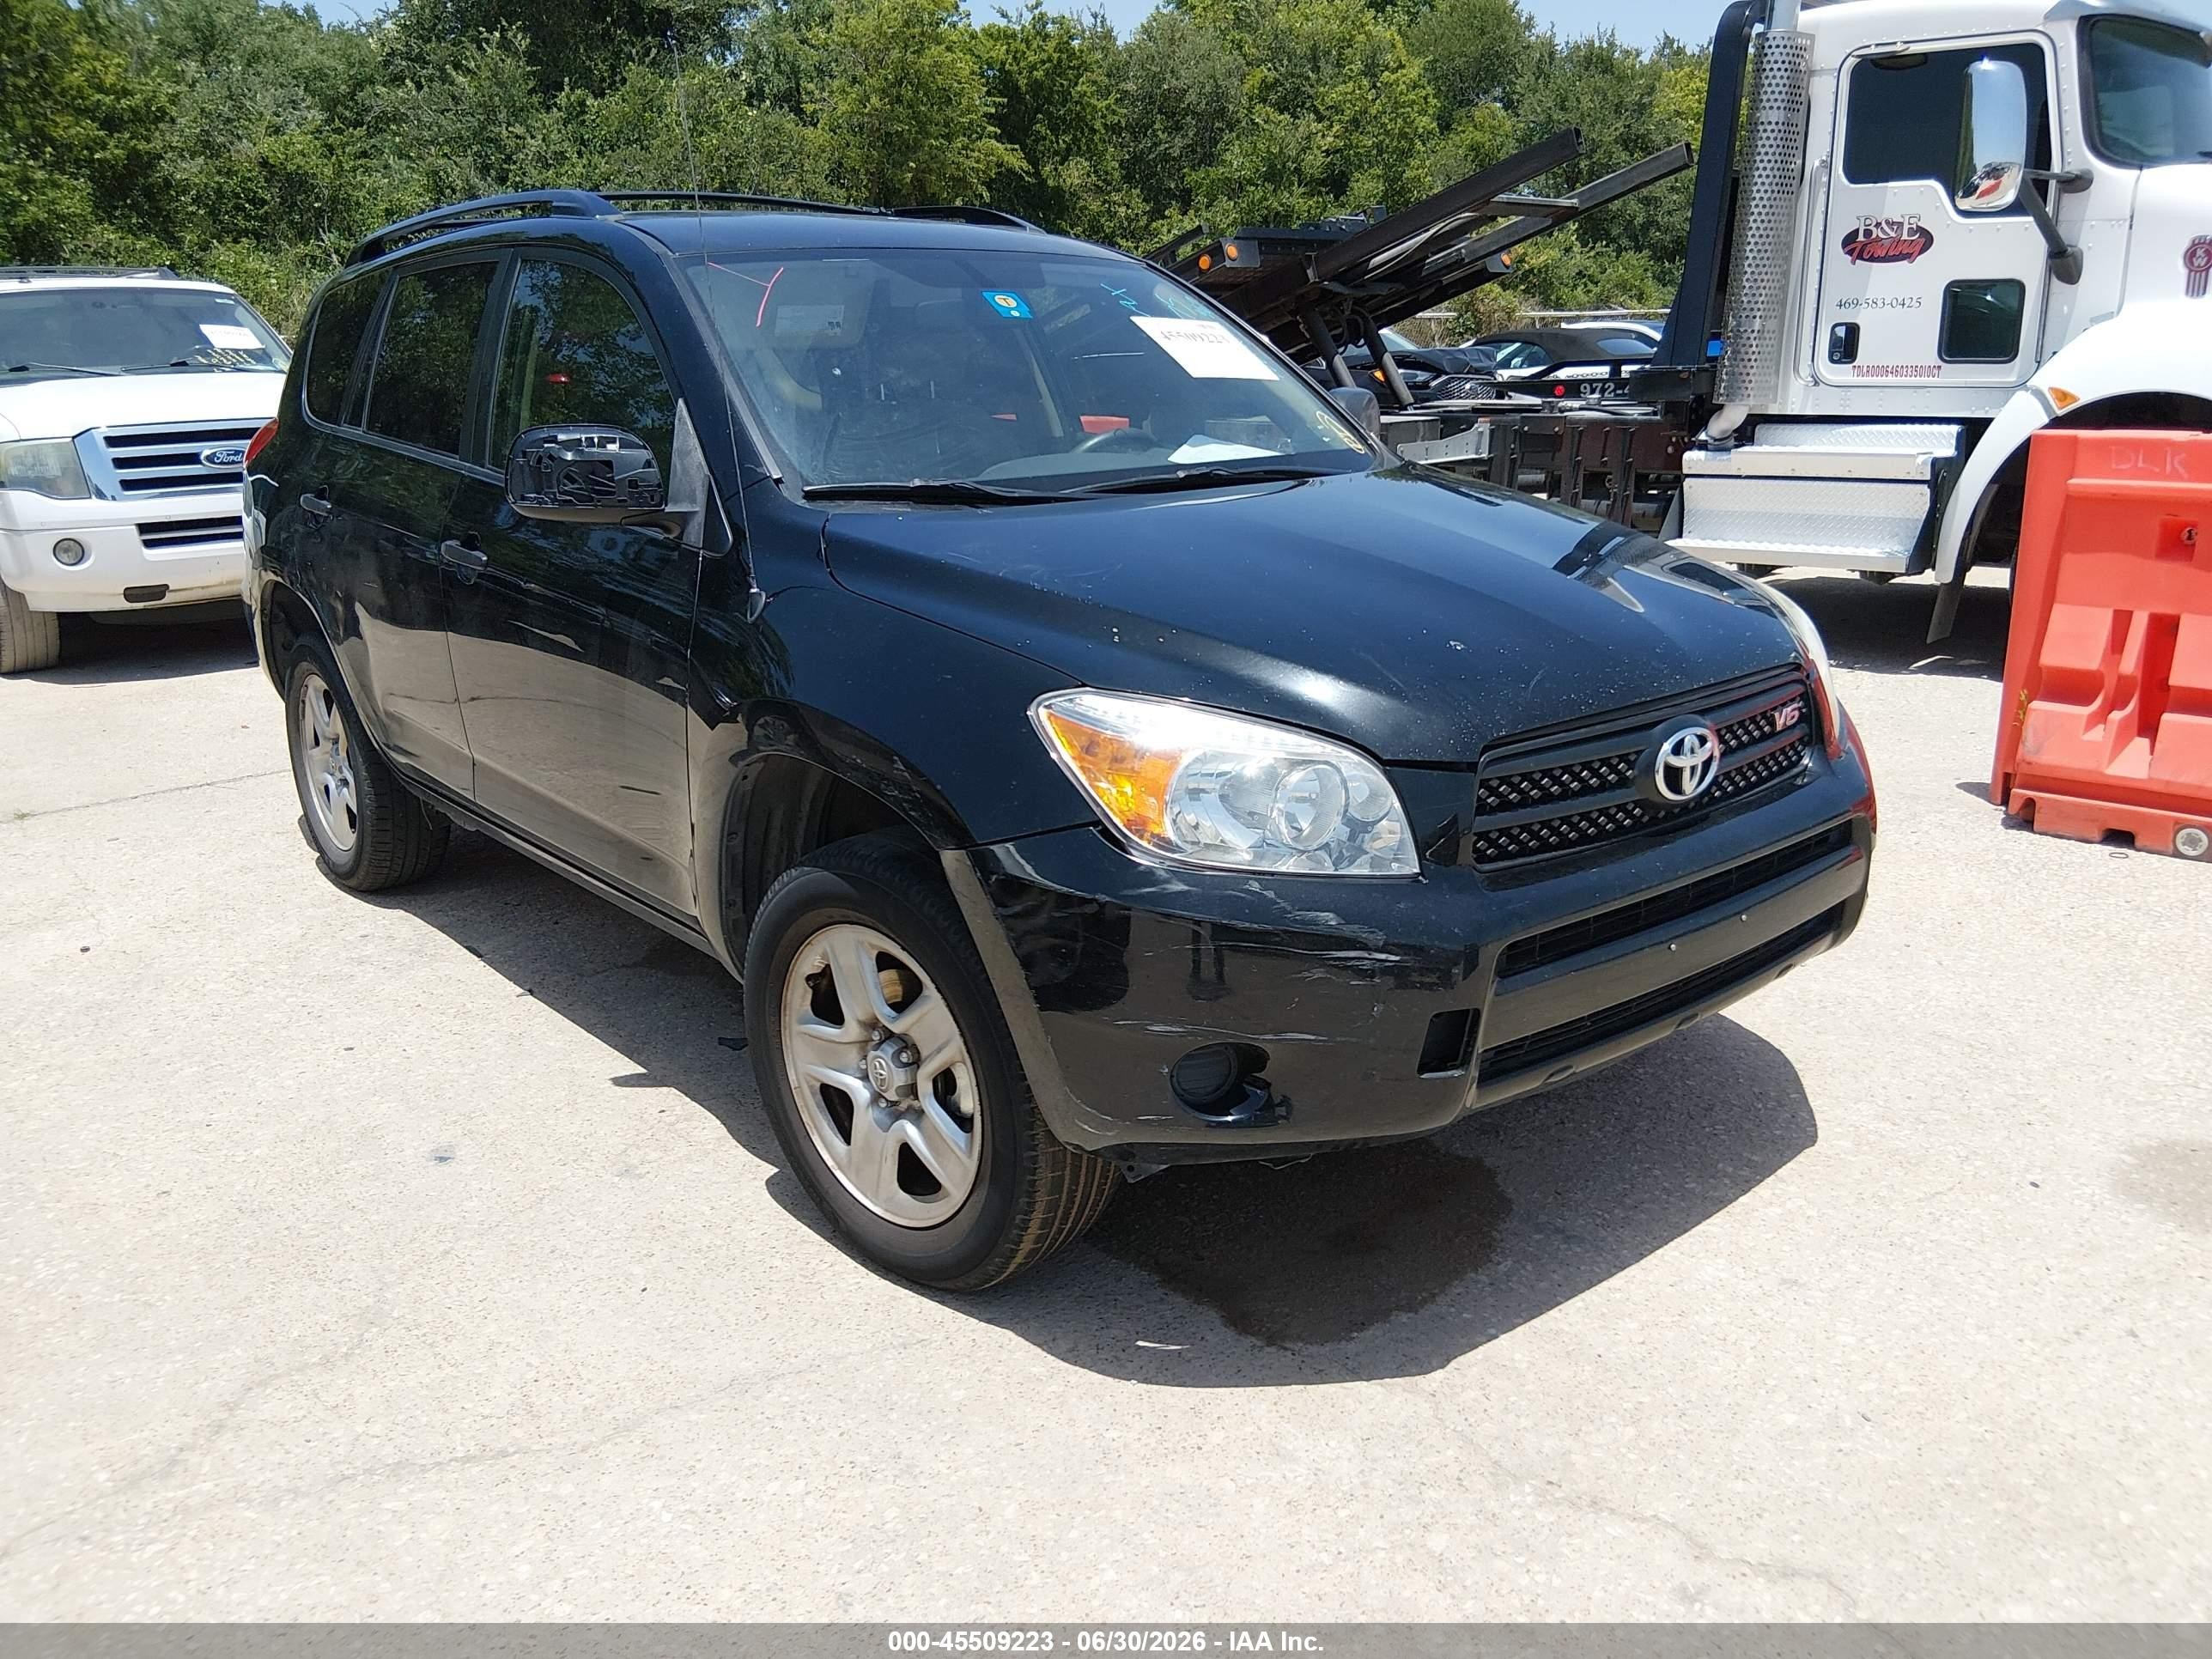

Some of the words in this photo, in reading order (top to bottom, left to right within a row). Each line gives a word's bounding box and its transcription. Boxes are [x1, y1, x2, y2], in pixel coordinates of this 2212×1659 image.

[1856, 213, 1921, 242] B&E
[1844, 234, 1925, 265] Towing
[1835, 296, 1923, 310] 469-583-0425
[214, 450, 243, 464] Ford
[1774, 702, 1800, 732] V6
